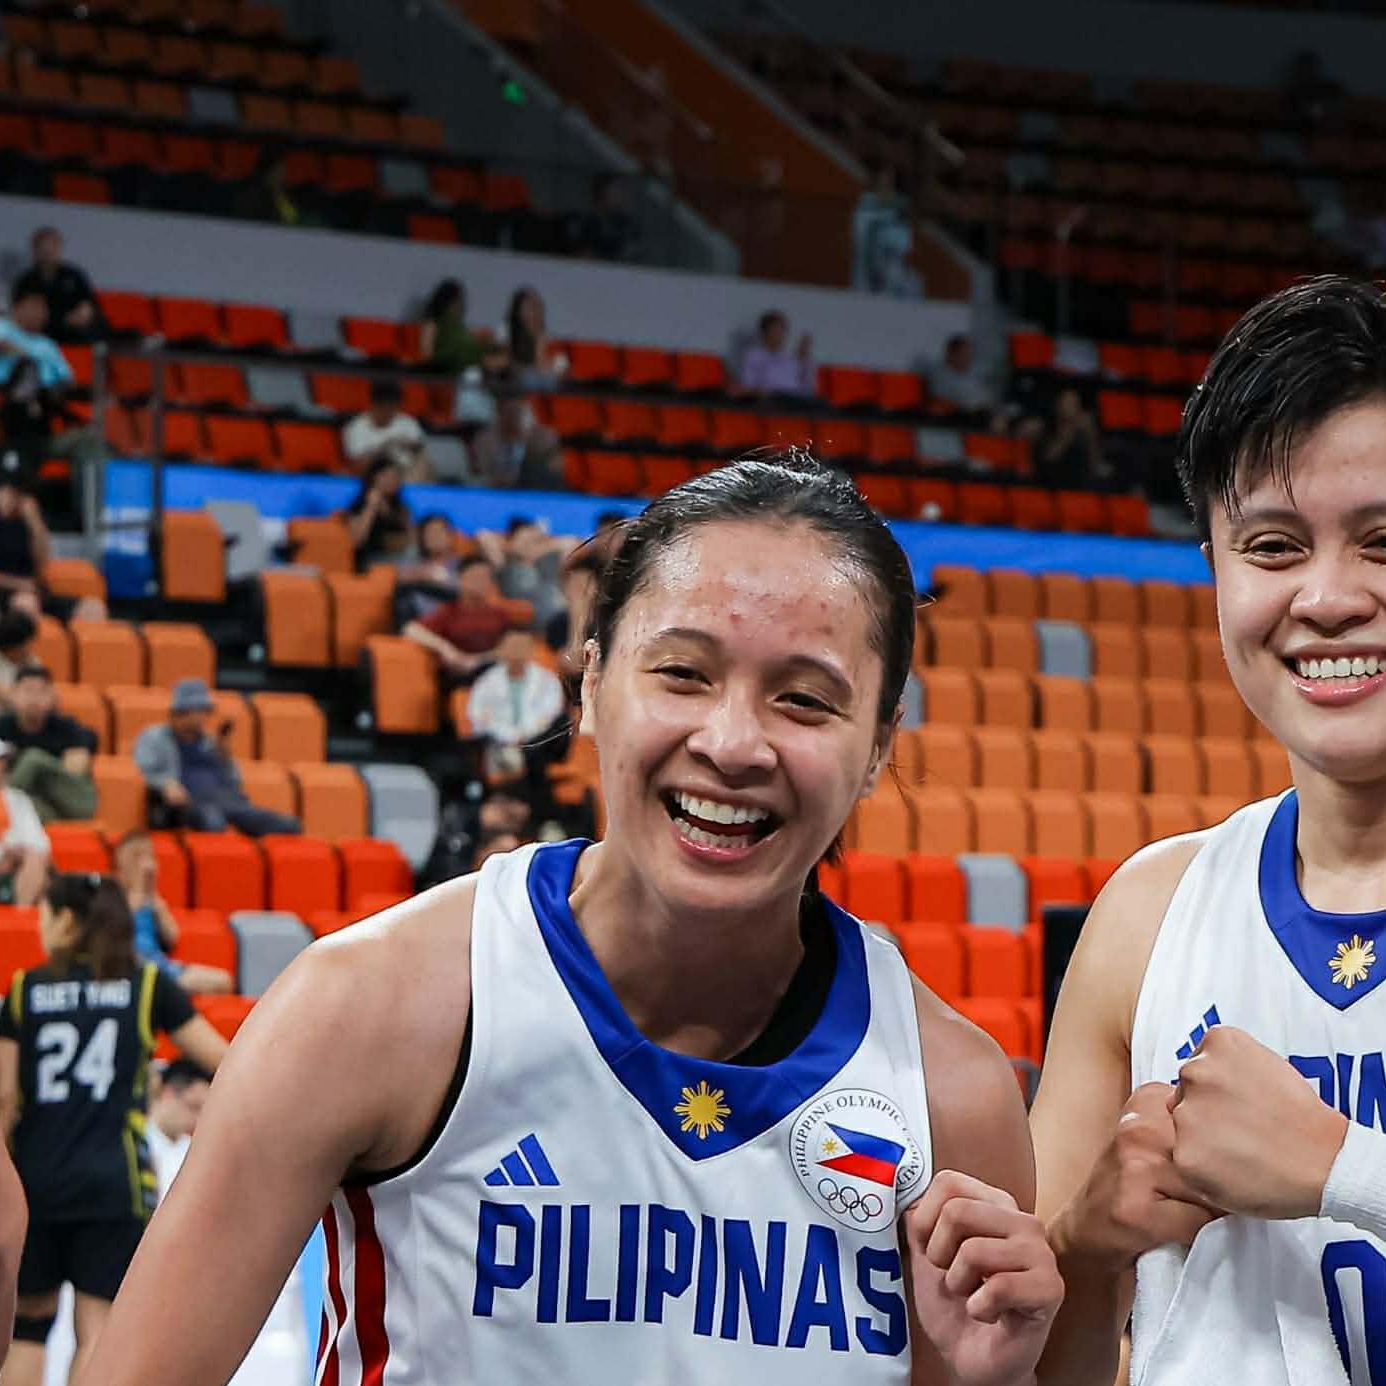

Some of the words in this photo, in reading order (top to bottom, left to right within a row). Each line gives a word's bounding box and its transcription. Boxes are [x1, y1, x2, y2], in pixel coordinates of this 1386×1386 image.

[37, 1018, 119, 1102] 24
[795, 1101, 835, 1178] PHILIPPINE
[836, 1095, 902, 1126] OLYMPIC
[473, 1199, 909, 1357] PILIPINAS
